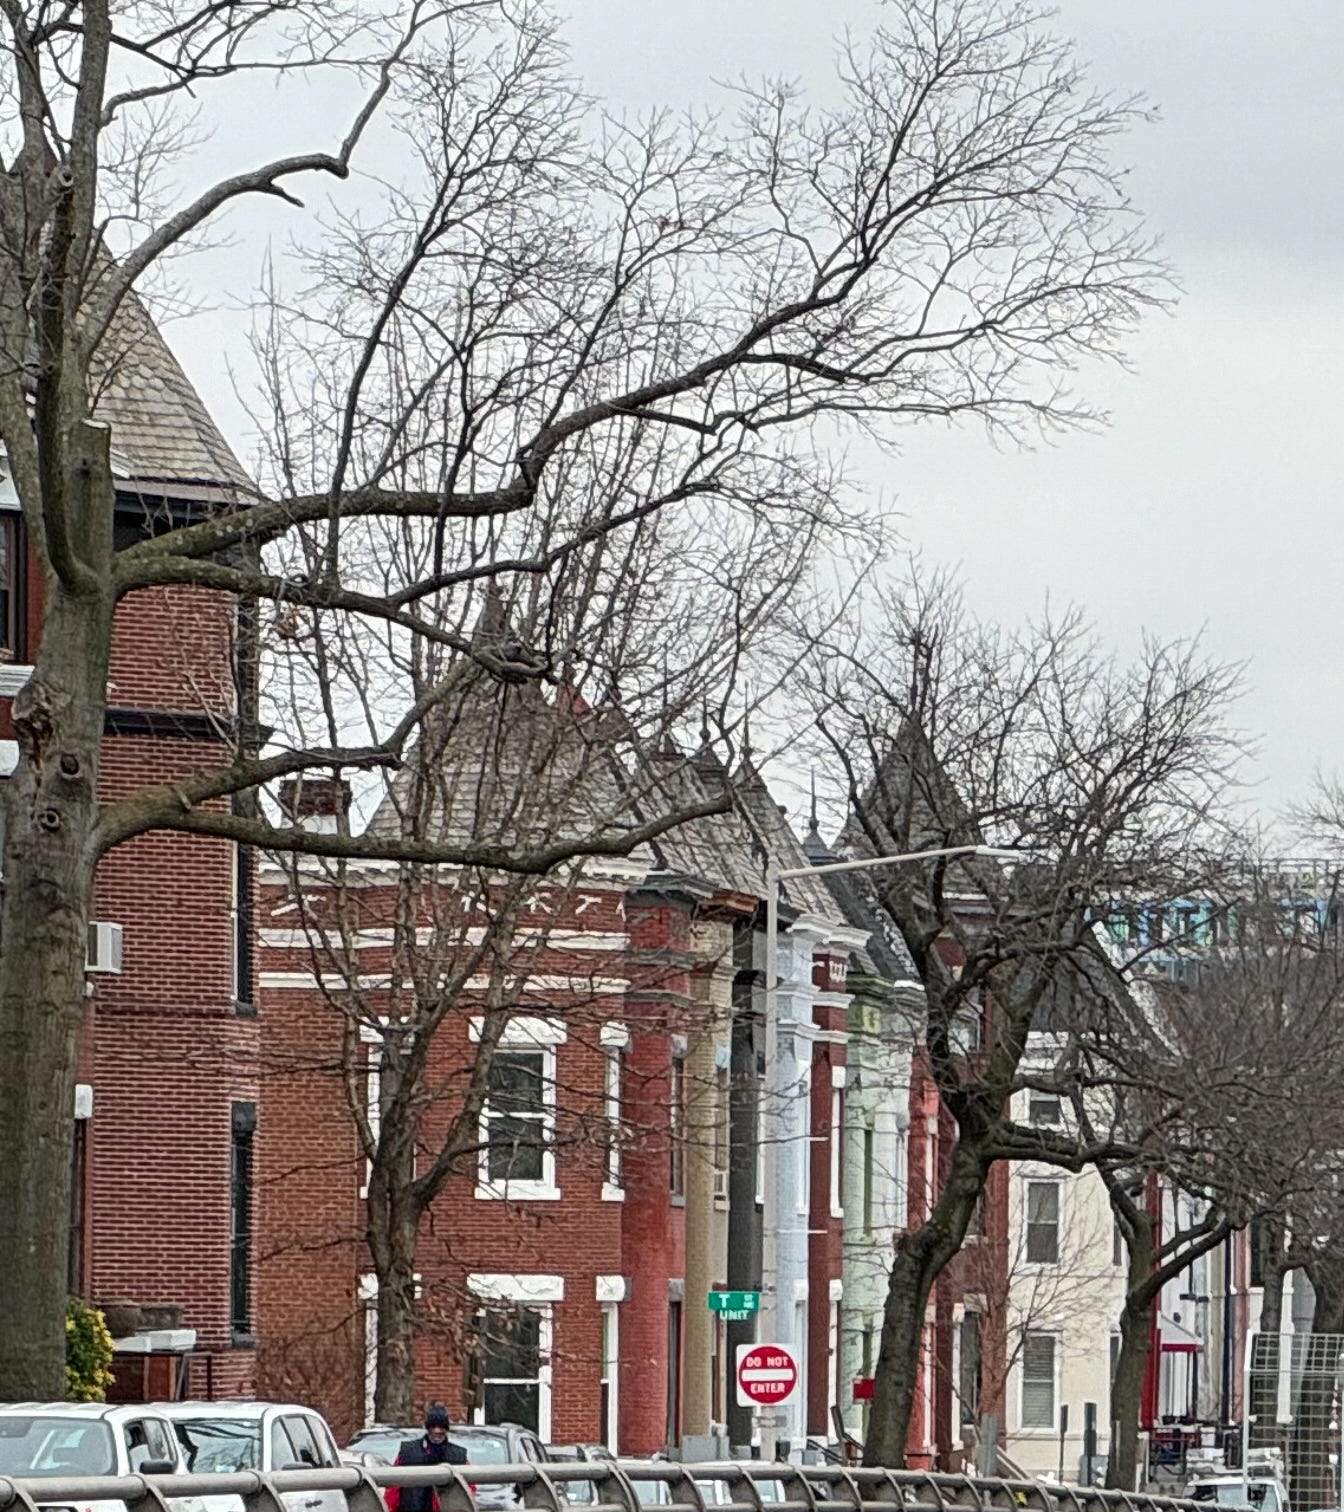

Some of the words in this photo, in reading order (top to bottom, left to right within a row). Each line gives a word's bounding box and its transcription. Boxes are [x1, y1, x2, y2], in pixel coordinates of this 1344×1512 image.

[719, 1294, 730, 1308] T
[720, 1310, 749, 1320] UNIT
[746, 1357, 761, 1367] DO
[767, 1357, 788, 1367] NOT
[750, 1383, 785, 1394] ENTER
